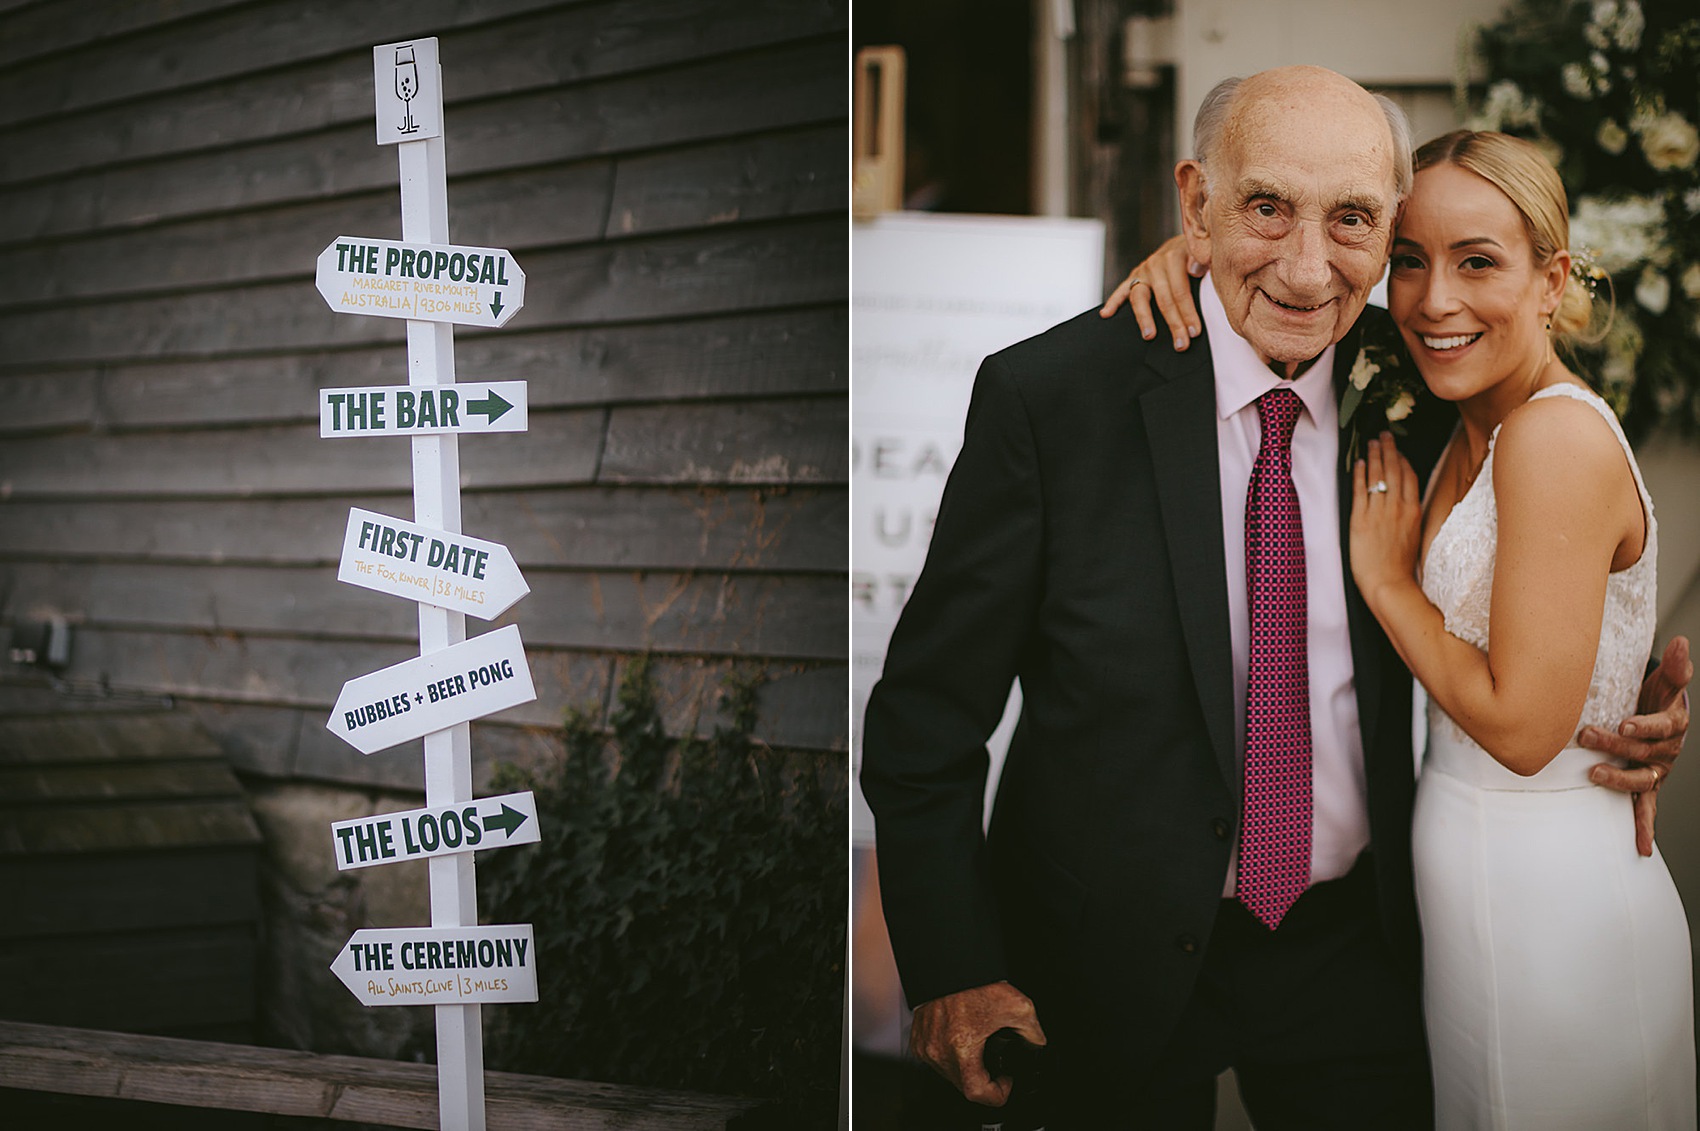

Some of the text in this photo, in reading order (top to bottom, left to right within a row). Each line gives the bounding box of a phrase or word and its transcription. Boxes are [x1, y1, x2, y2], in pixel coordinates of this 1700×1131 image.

[336, 244, 509, 286] THE PROPOSAL
[352, 278, 409, 292] MARGARET
[341, 291, 411, 310] AUSTRALIA
[420, 298, 452, 312] 9306
[453, 301, 482, 315] MILES
[328, 390, 460, 430] THE BAR
[358, 520, 489, 580] FIRST DATE
[354, 560, 374, 574] THE
[454, 586, 485, 604] MILES
[344, 659, 514, 730] BUBBLES + BEER PONG
[337, 807, 482, 864] THE LOOS
[350, 938, 528, 971] THE CEREMONY
[475, 979, 508, 991] MILES
